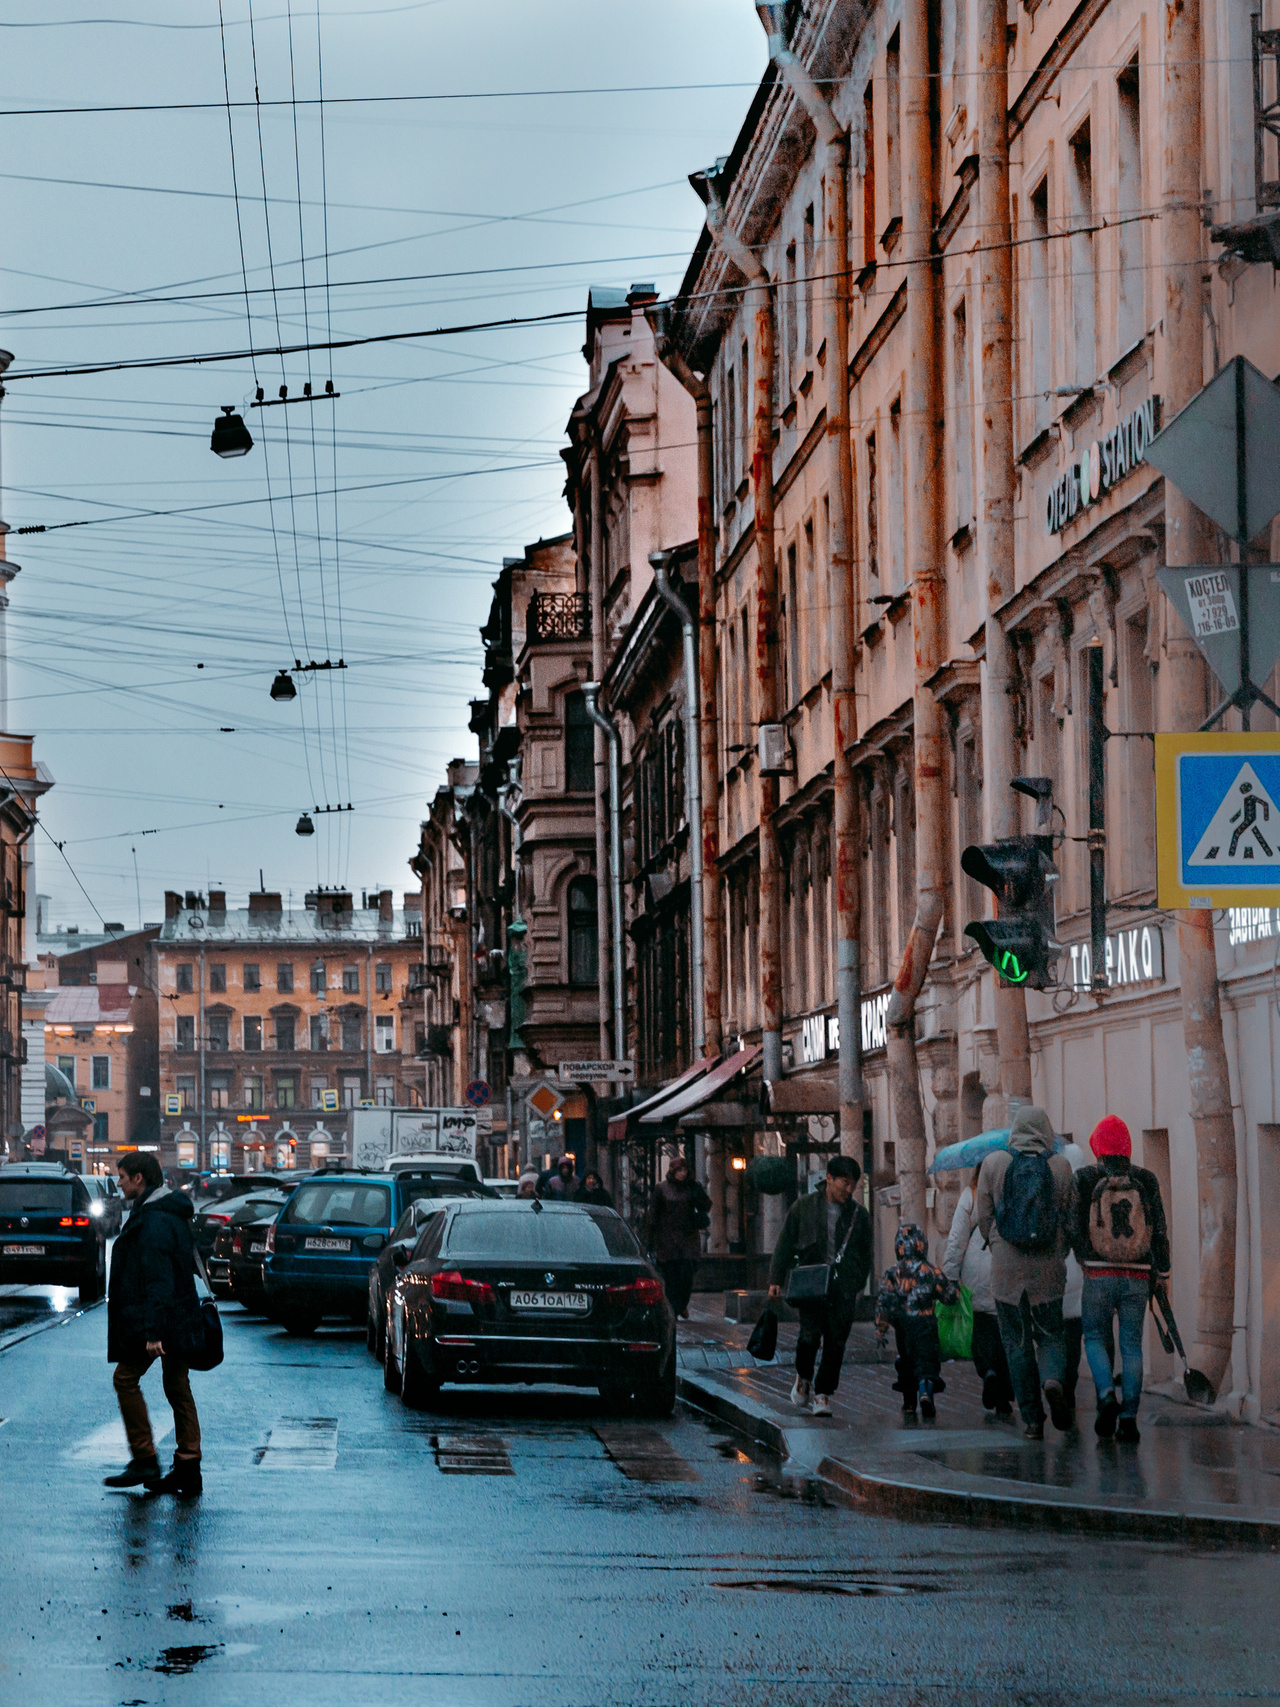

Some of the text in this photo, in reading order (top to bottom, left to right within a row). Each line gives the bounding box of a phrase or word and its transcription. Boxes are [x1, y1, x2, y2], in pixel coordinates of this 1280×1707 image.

[1047, 395, 1154, 535] ОТЕЛЬ STATION
[1188, 574, 1229, 598] ХОСТЕЛ
[1228, 907, 1272, 947] ЗАВТРАК
[563, 1063, 615, 1071] ПОВАРСКОЙ
